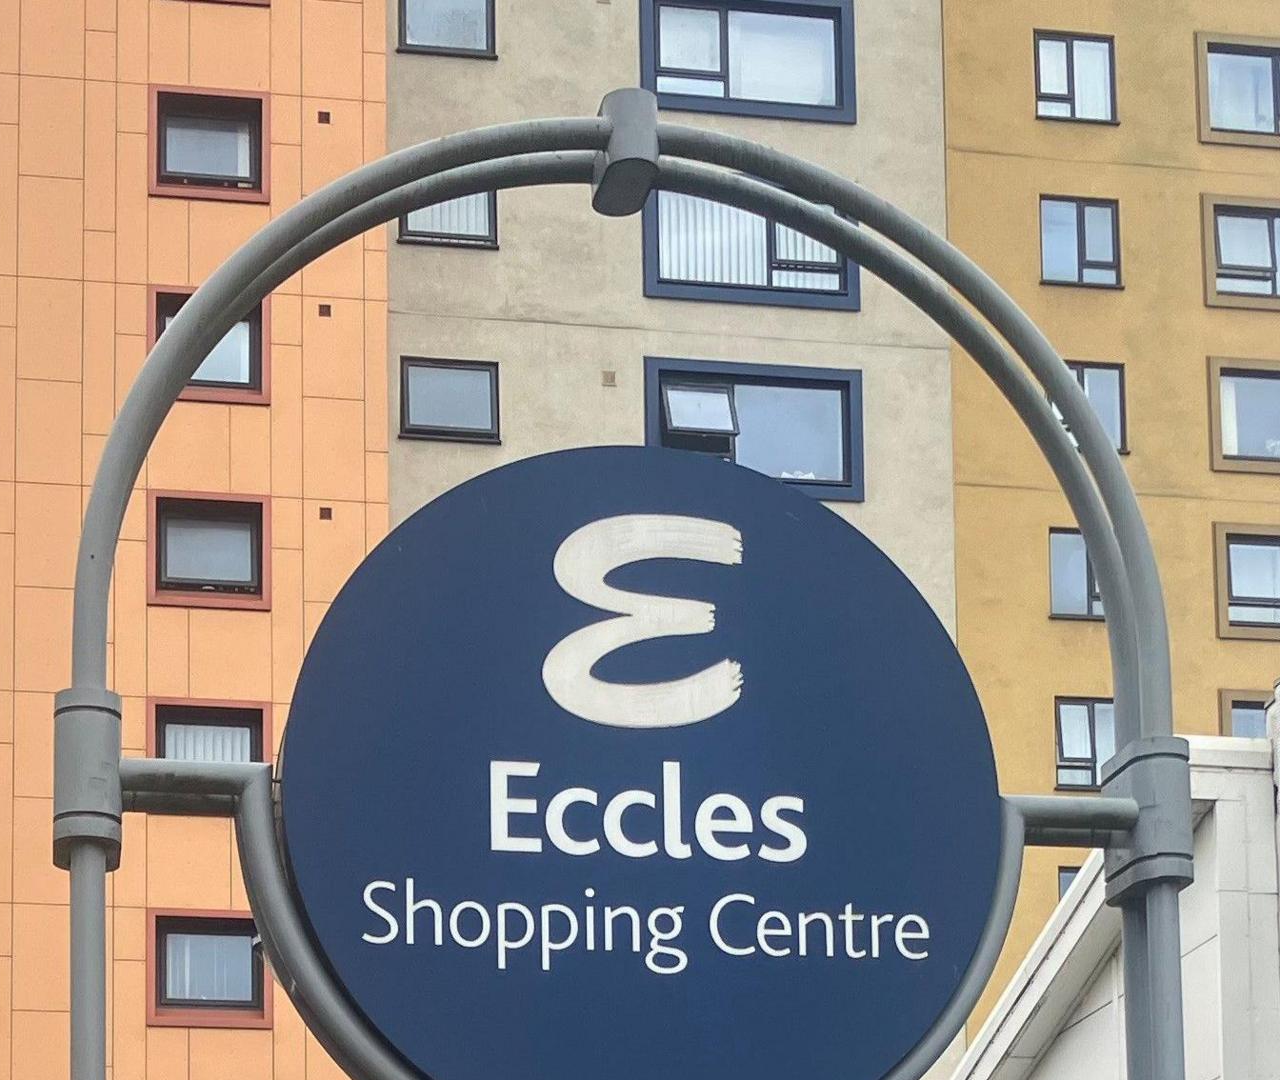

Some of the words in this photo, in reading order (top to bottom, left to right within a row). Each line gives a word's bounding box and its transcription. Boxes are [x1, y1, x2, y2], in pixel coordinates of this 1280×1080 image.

[489, 760, 808, 863] Eccles
[361, 878, 688, 974] Shopping
[710, 893, 930, 960] Centre
